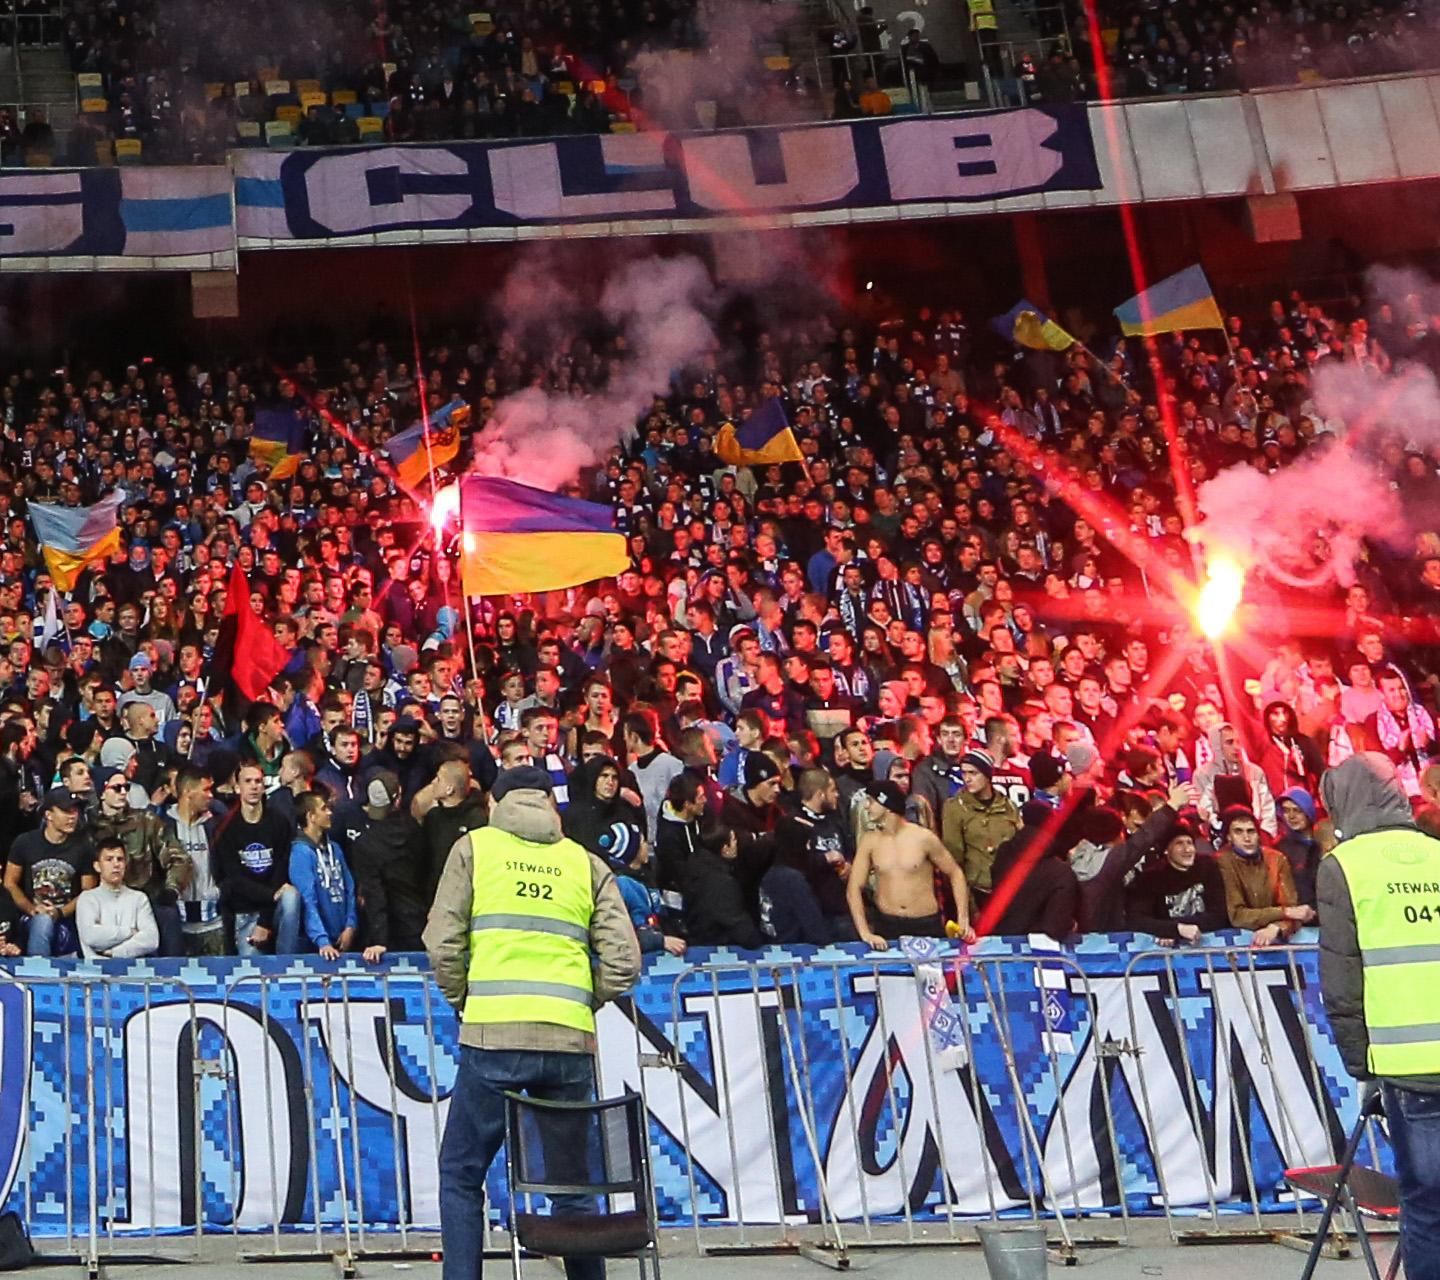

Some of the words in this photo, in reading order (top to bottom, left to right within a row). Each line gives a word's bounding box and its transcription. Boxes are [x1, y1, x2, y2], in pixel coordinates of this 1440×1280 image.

[306, 112, 1063, 232] CLUB
[505, 861, 562, 877] STEWARD
[515, 881, 553, 900] 292
